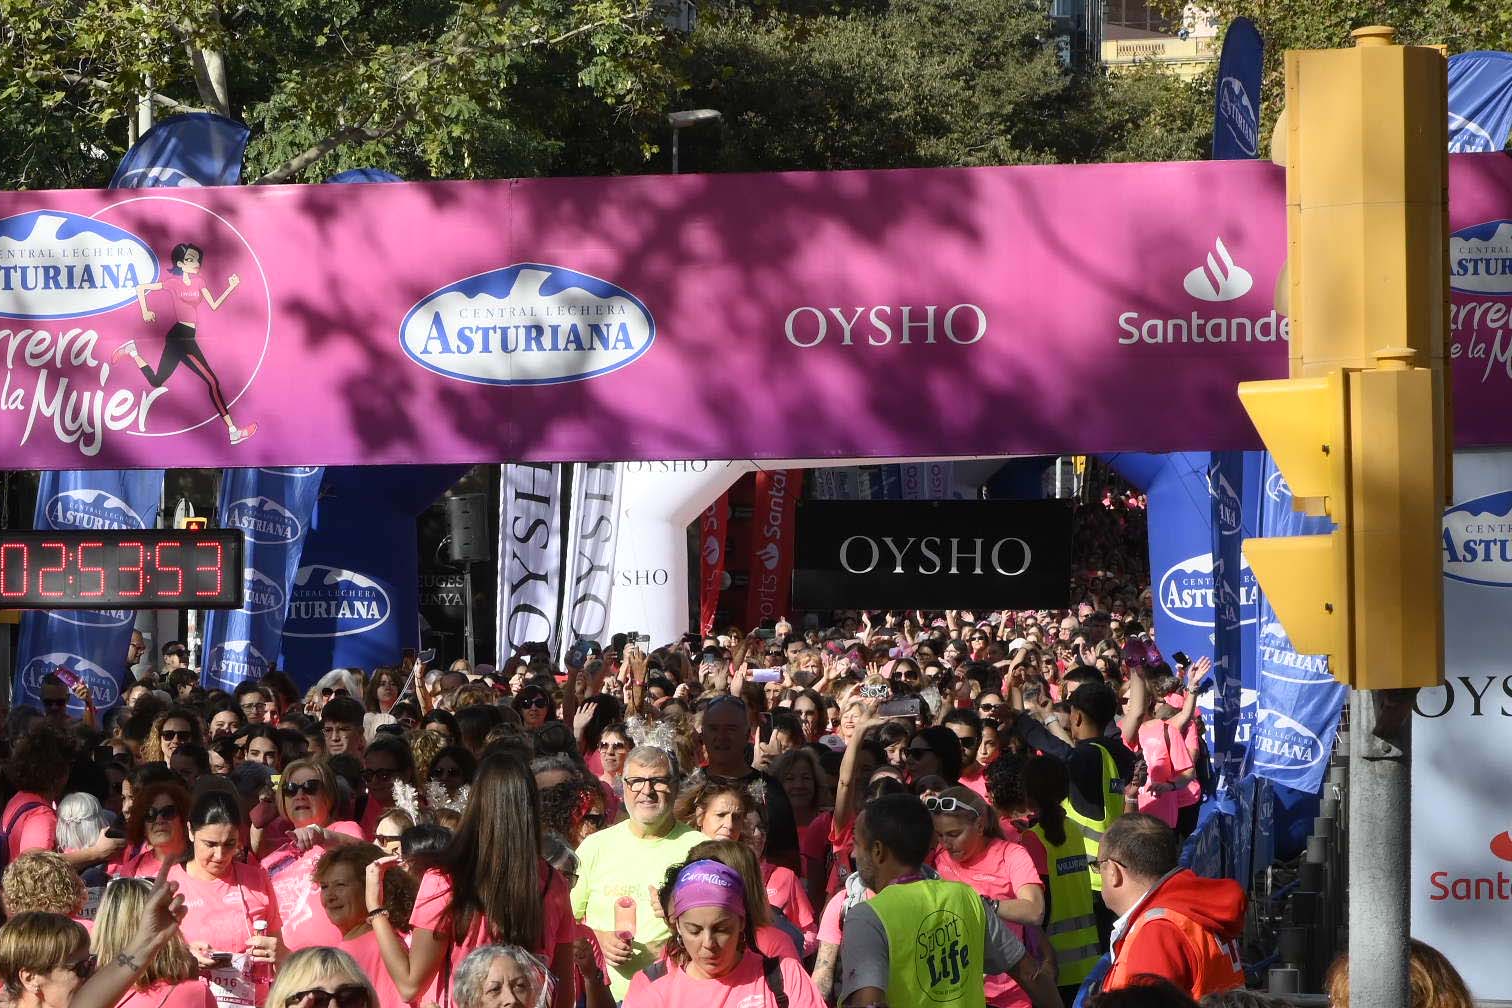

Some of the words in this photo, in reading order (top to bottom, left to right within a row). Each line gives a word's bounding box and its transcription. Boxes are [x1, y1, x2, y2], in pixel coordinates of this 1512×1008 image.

[62, 247, 134, 259] LECHERA
[419, 310, 635, 355] ASTURIANA
[458, 306, 538, 319] CENTRAL
[545, 304, 627, 318] LECHERA
[784, 303, 988, 348] OYSHO
[1117, 308, 1289, 345] Santande
[1469, 331, 1486, 358] la
[0, 372, 25, 411] la
[20, 362, 168, 456] Mujer
[0, 541, 223, 598] 02:53:53
[507, 463, 553, 651] OYSH
[570, 463, 616, 640] OYSH
[838, 534, 1033, 579] OYSHO
[926, 939, 970, 989] Life
